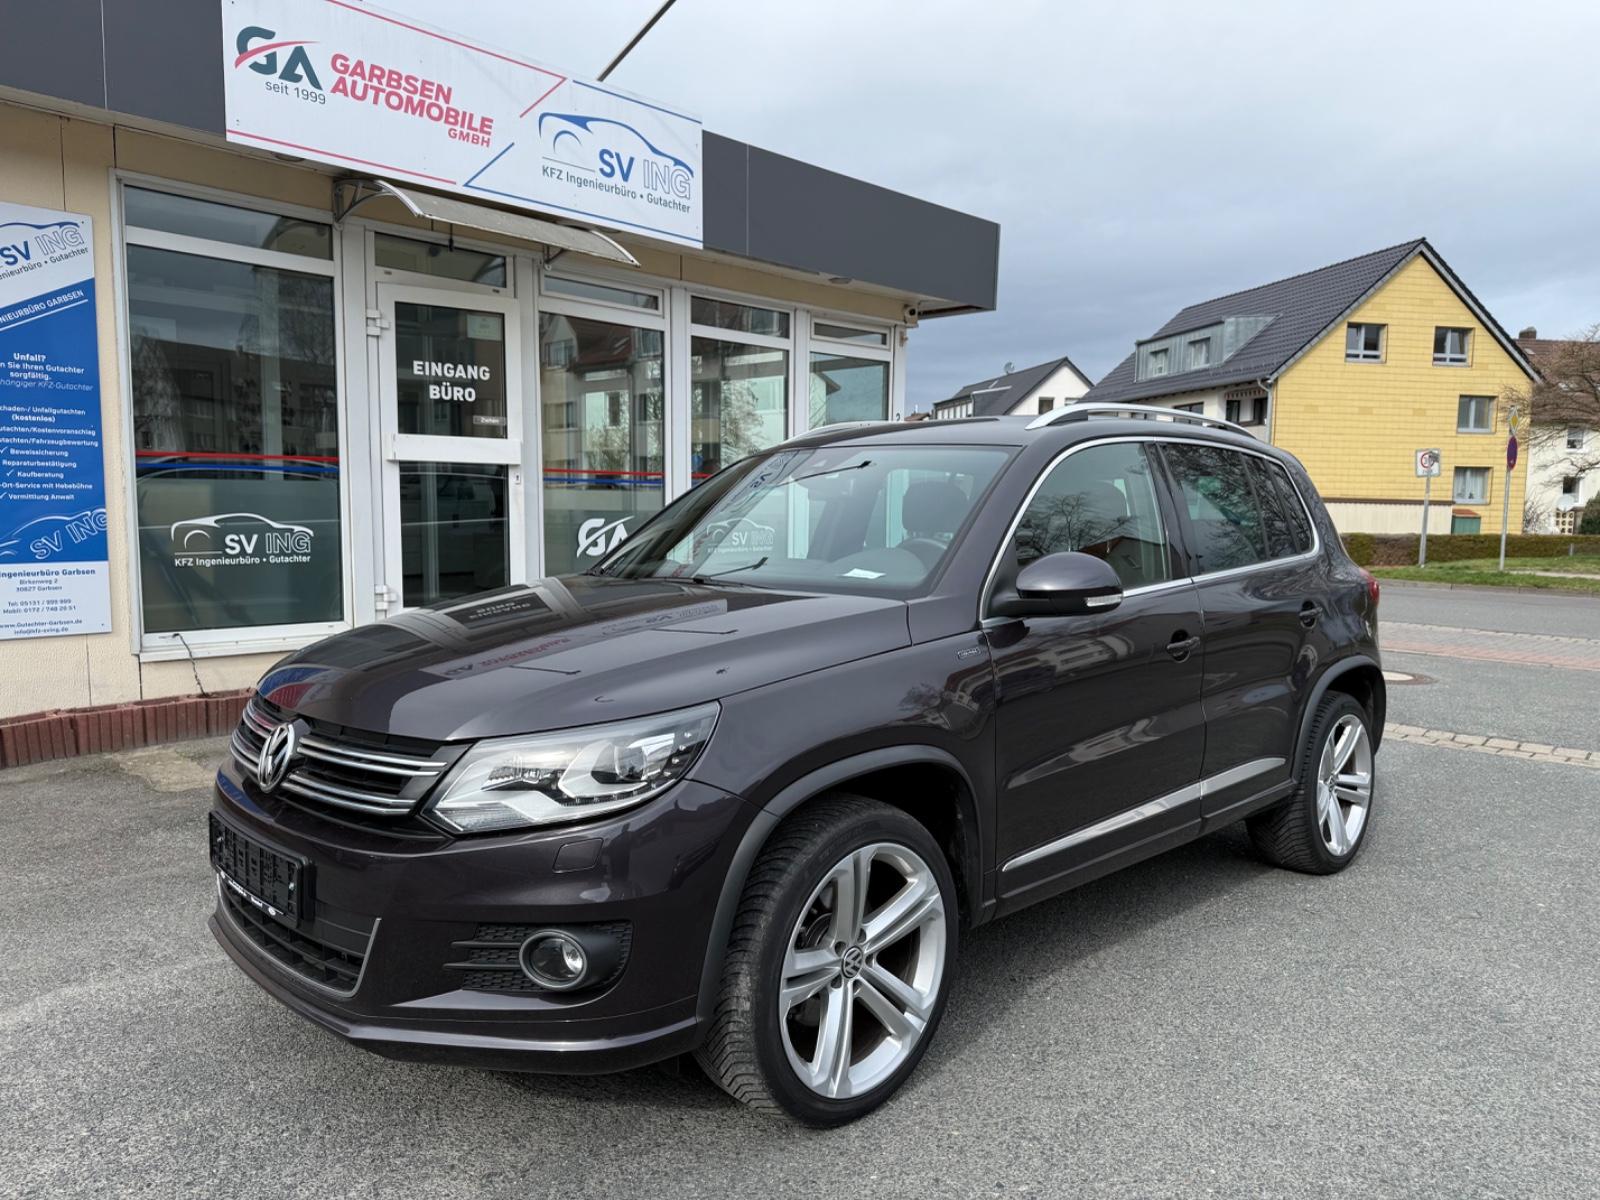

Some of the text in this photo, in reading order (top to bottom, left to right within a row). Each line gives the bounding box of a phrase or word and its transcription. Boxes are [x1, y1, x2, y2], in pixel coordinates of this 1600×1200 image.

[331, 53, 452, 105] GARBSEN
[265, 80, 326, 105] seit 1999
[331, 78, 494, 137] AUTOMOBILE
[448, 128, 492, 151] GMBH
[598, 149, 691, 200] SV ING
[542, 165, 691, 214] KFZ Ingenieurbüro Gutachter
[0, 225, 85, 266] SV ING
[49, 247, 88, 264] Gutachter
[47, 289, 84, 308] GARBSEN
[7, 361, 20, 369] Sie
[22, 362, 44, 371] Ihren
[45, 364, 85, 375] Gutachter
[13, 352, 46, 362] Unfall?
[413, 360, 491, 381] EINGANG
[429, 381, 476, 402] BÜRO
[29, 530, 64, 560] SV
[225, 532, 311, 555] SV ING
[732, 531, 748, 545] SV
[62, 567, 96, 576] Garbsen
[174, 554, 311, 568] KFZ Ingenieurbüro Gutachter
